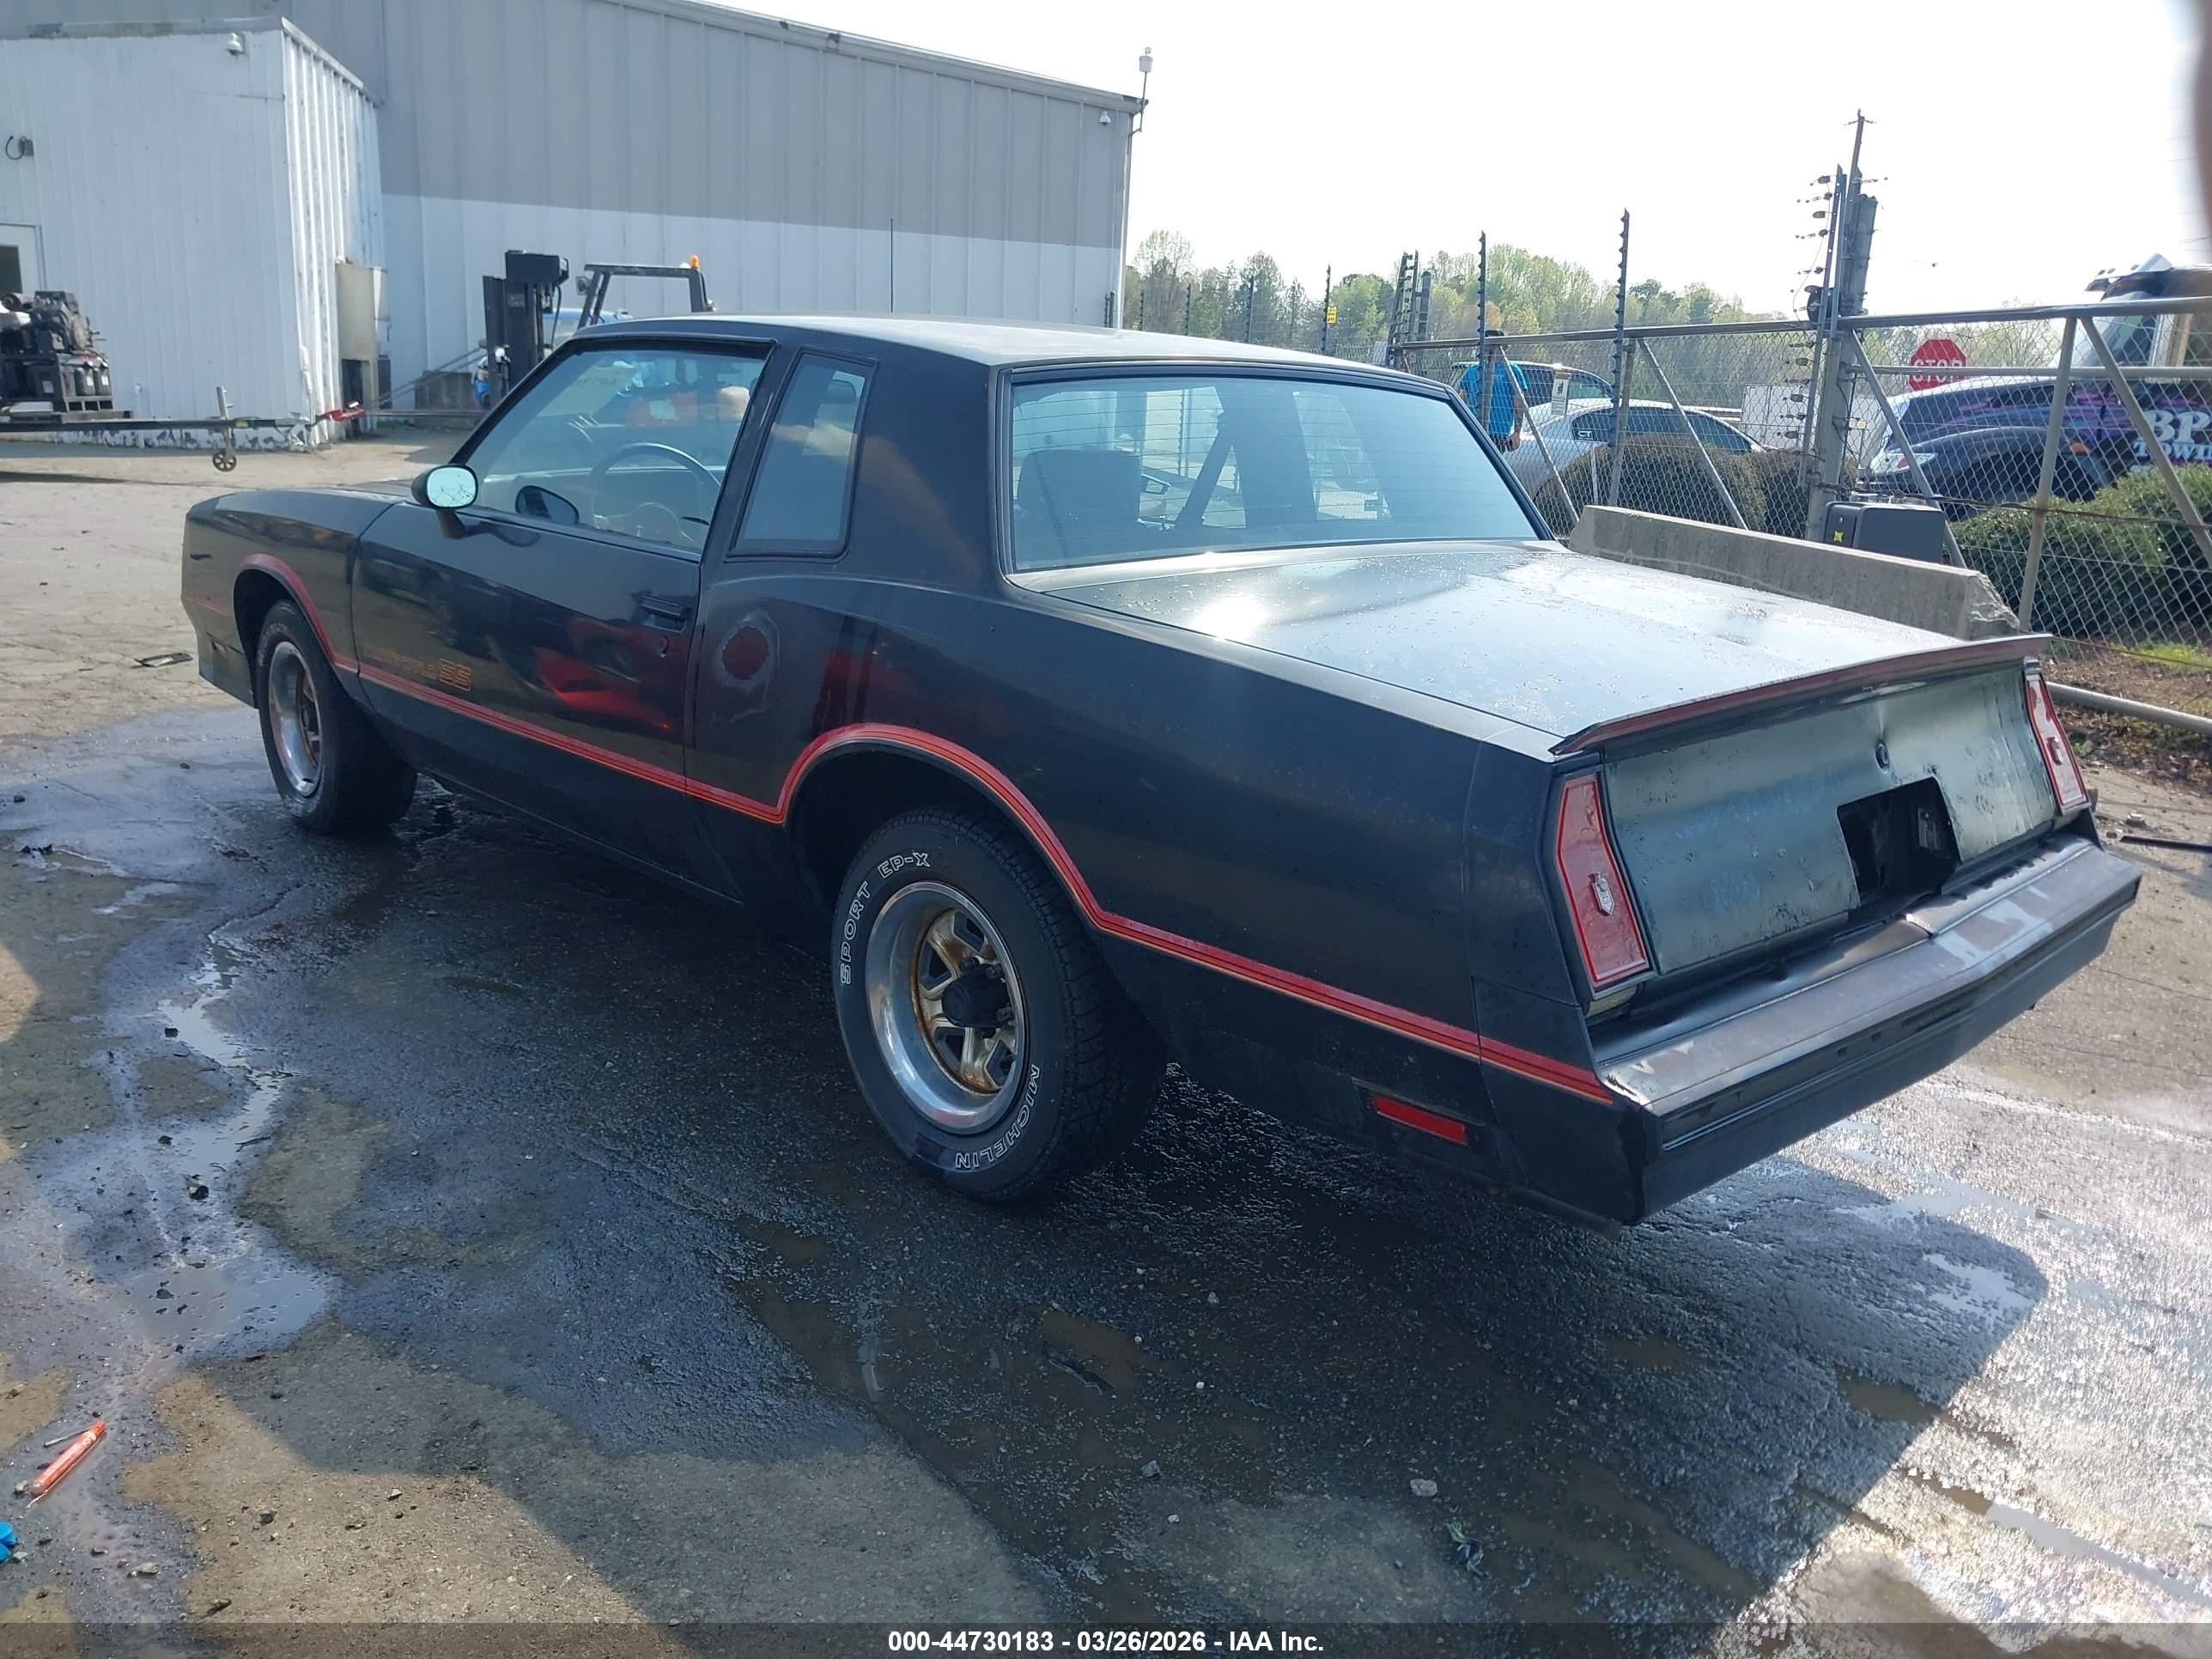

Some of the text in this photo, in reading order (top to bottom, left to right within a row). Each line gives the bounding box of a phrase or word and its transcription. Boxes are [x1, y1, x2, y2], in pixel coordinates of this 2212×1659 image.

[1912, 358, 1963, 383] STOP
[839, 851, 931, 985] SPORT EP-X
[955, 1064, 1042, 1169] MICHELIN
